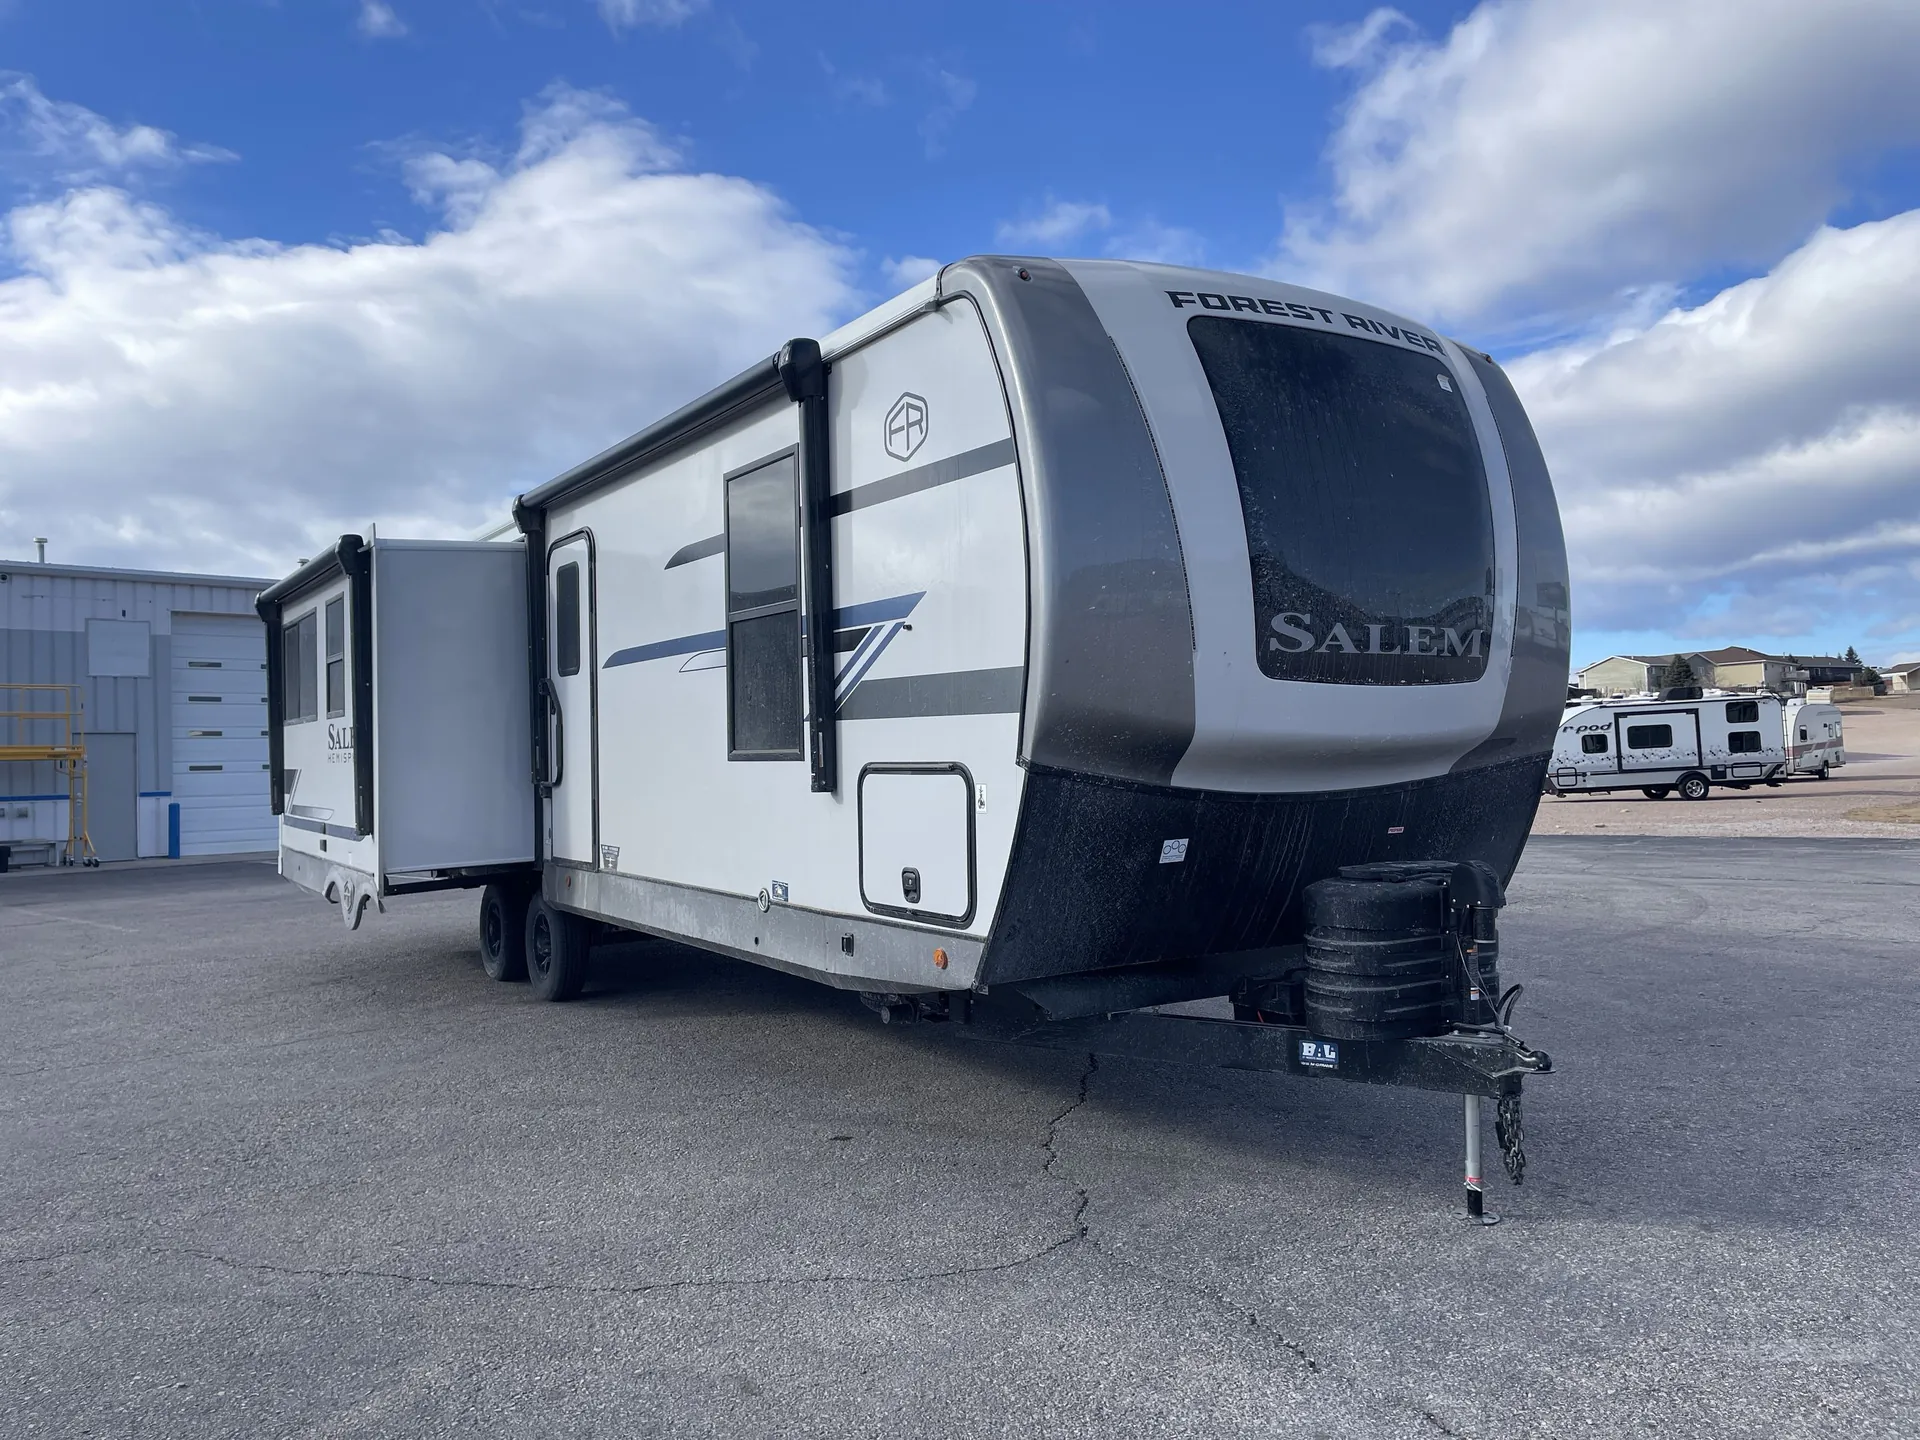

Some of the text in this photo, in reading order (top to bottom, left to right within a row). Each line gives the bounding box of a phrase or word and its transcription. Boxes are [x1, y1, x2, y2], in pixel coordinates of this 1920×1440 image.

[1164, 290, 1447, 357] FOREST RIVER
[1269, 611, 1486, 659] SALEM
